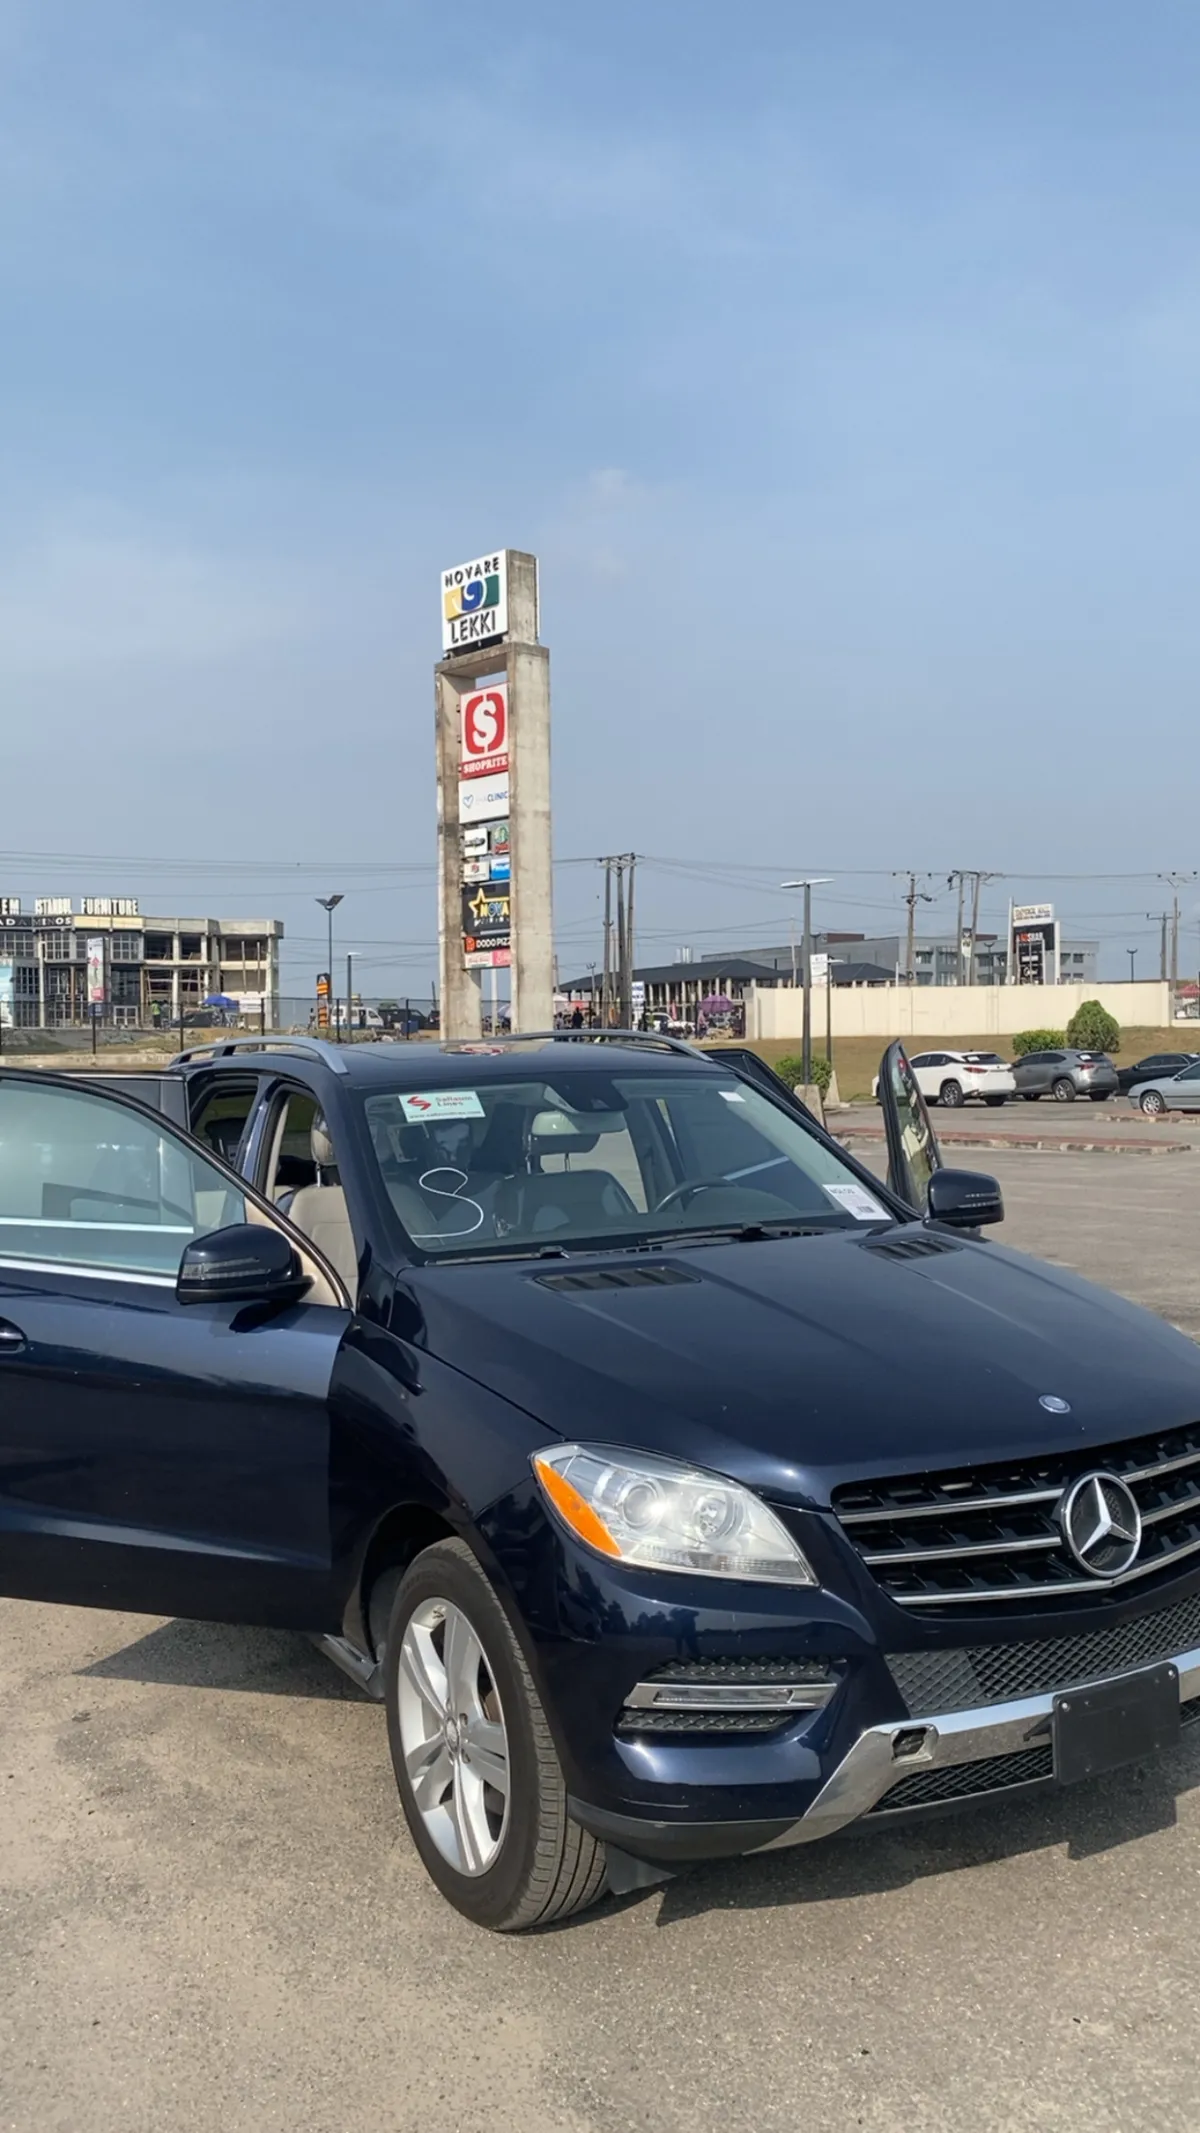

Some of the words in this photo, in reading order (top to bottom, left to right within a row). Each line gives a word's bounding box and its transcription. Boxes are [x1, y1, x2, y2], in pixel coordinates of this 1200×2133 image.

[444, 557, 499, 587] NOVARE
[451, 610, 496, 644] LEKKI
[463, 756, 508, 774] SHOPRITE
[81, 898, 139, 916] FURNITURE
[480, 901, 509, 918] NOVA
[476, 938, 496, 949] DODO
